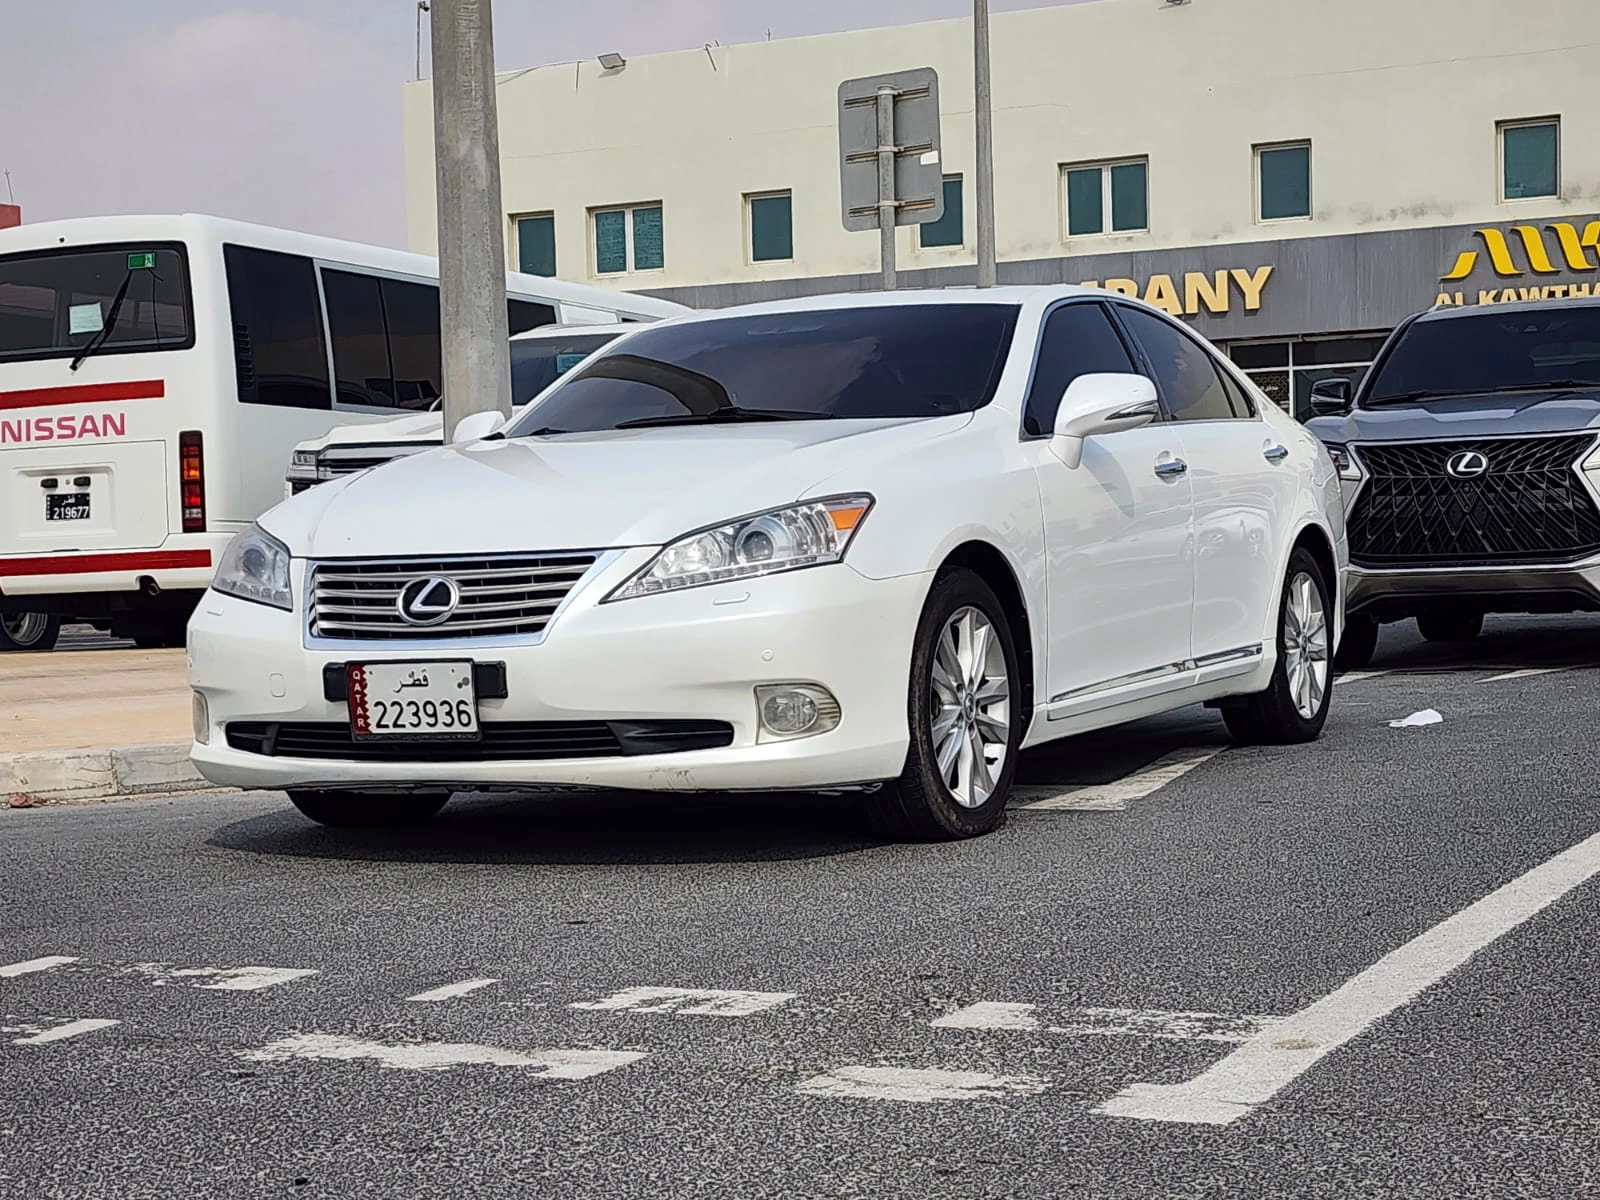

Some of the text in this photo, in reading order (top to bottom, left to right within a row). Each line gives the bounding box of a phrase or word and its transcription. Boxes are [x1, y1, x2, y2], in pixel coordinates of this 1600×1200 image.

[1, 412, 126, 443] NISSAN
[53, 506, 89, 519] 219677
[392, 668, 429, 694] قطر
[352, 669, 366, 728] QATAR
[373, 699, 472, 729] 223936
